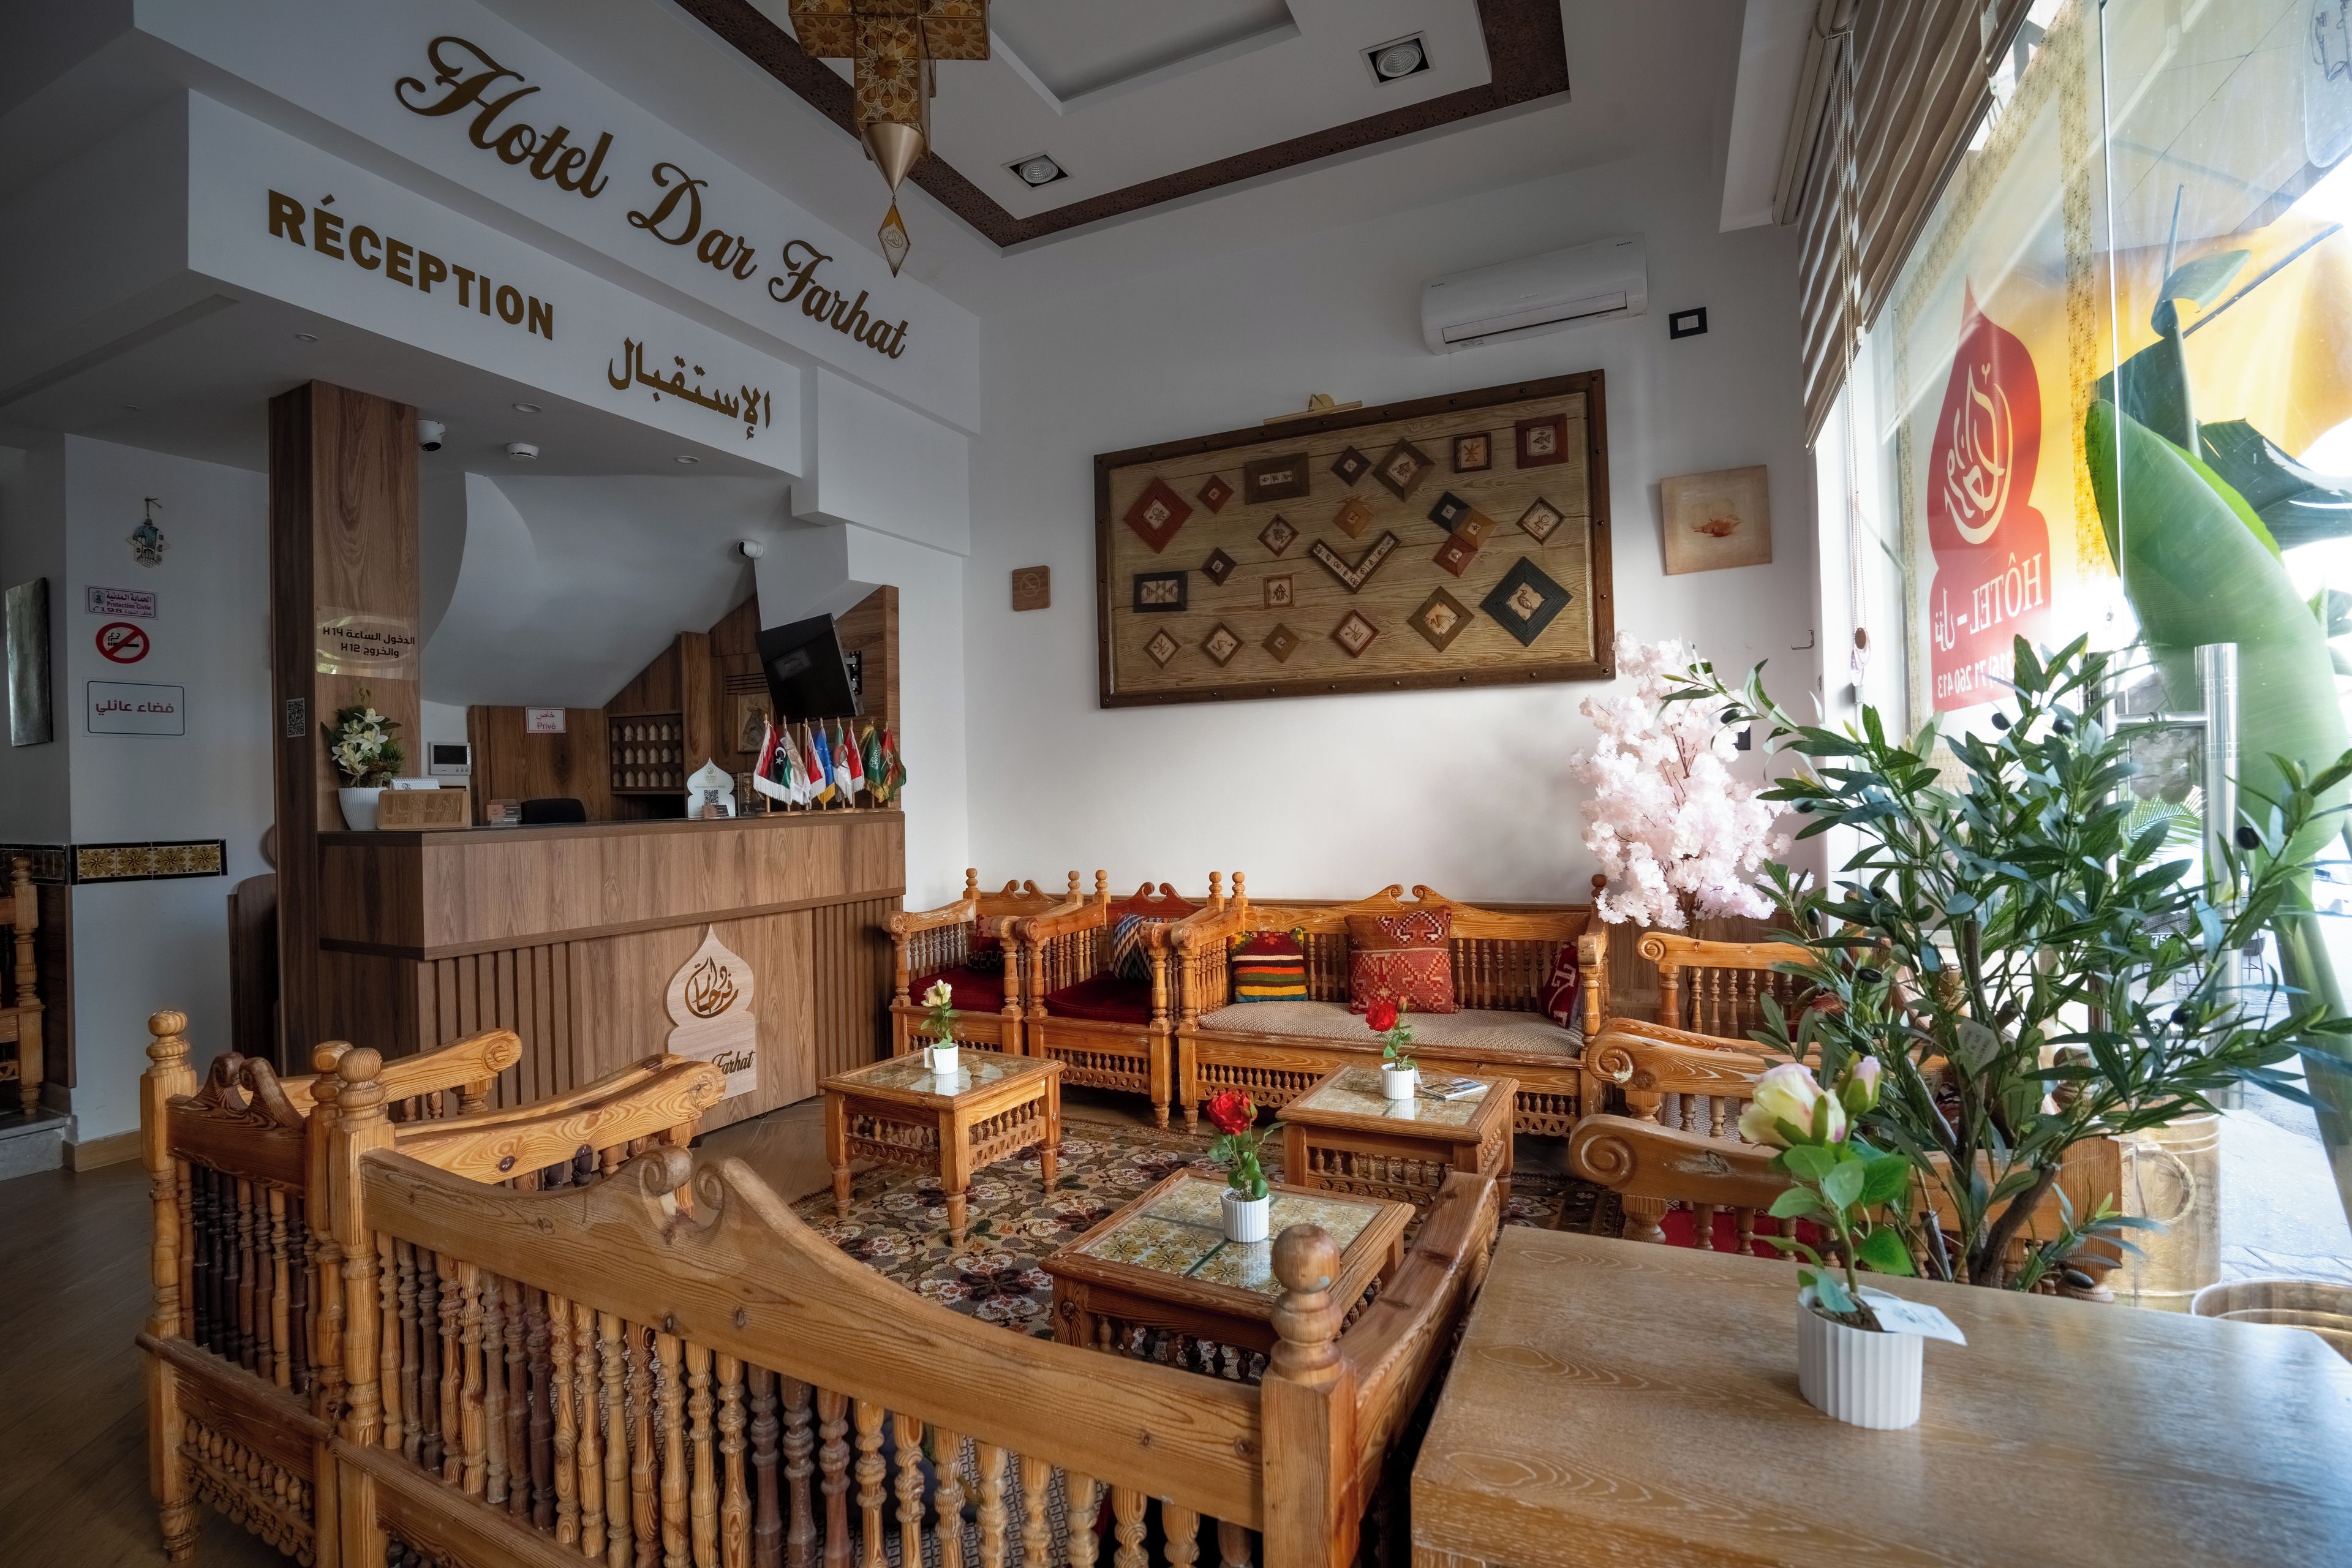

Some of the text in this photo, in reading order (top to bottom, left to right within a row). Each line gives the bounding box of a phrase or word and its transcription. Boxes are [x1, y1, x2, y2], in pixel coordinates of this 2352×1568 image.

[395, 36, 909, 360] Hotel Dar Farhat
[268, 188, 554, 341] RÉCEPTION
[608, 336, 771, 441] الإستقبال
[107, 590, 152, 604] الحماية المدنية
[323, 627, 415, 645] الدخول الساعة 14 H
[341, 643, 399, 658] والخروج 12 H
[96, 699, 175, 715] فضاء عائلي
[536, 710, 556, 720] خاص
[712, 1049, 756, 1076] Farhat
